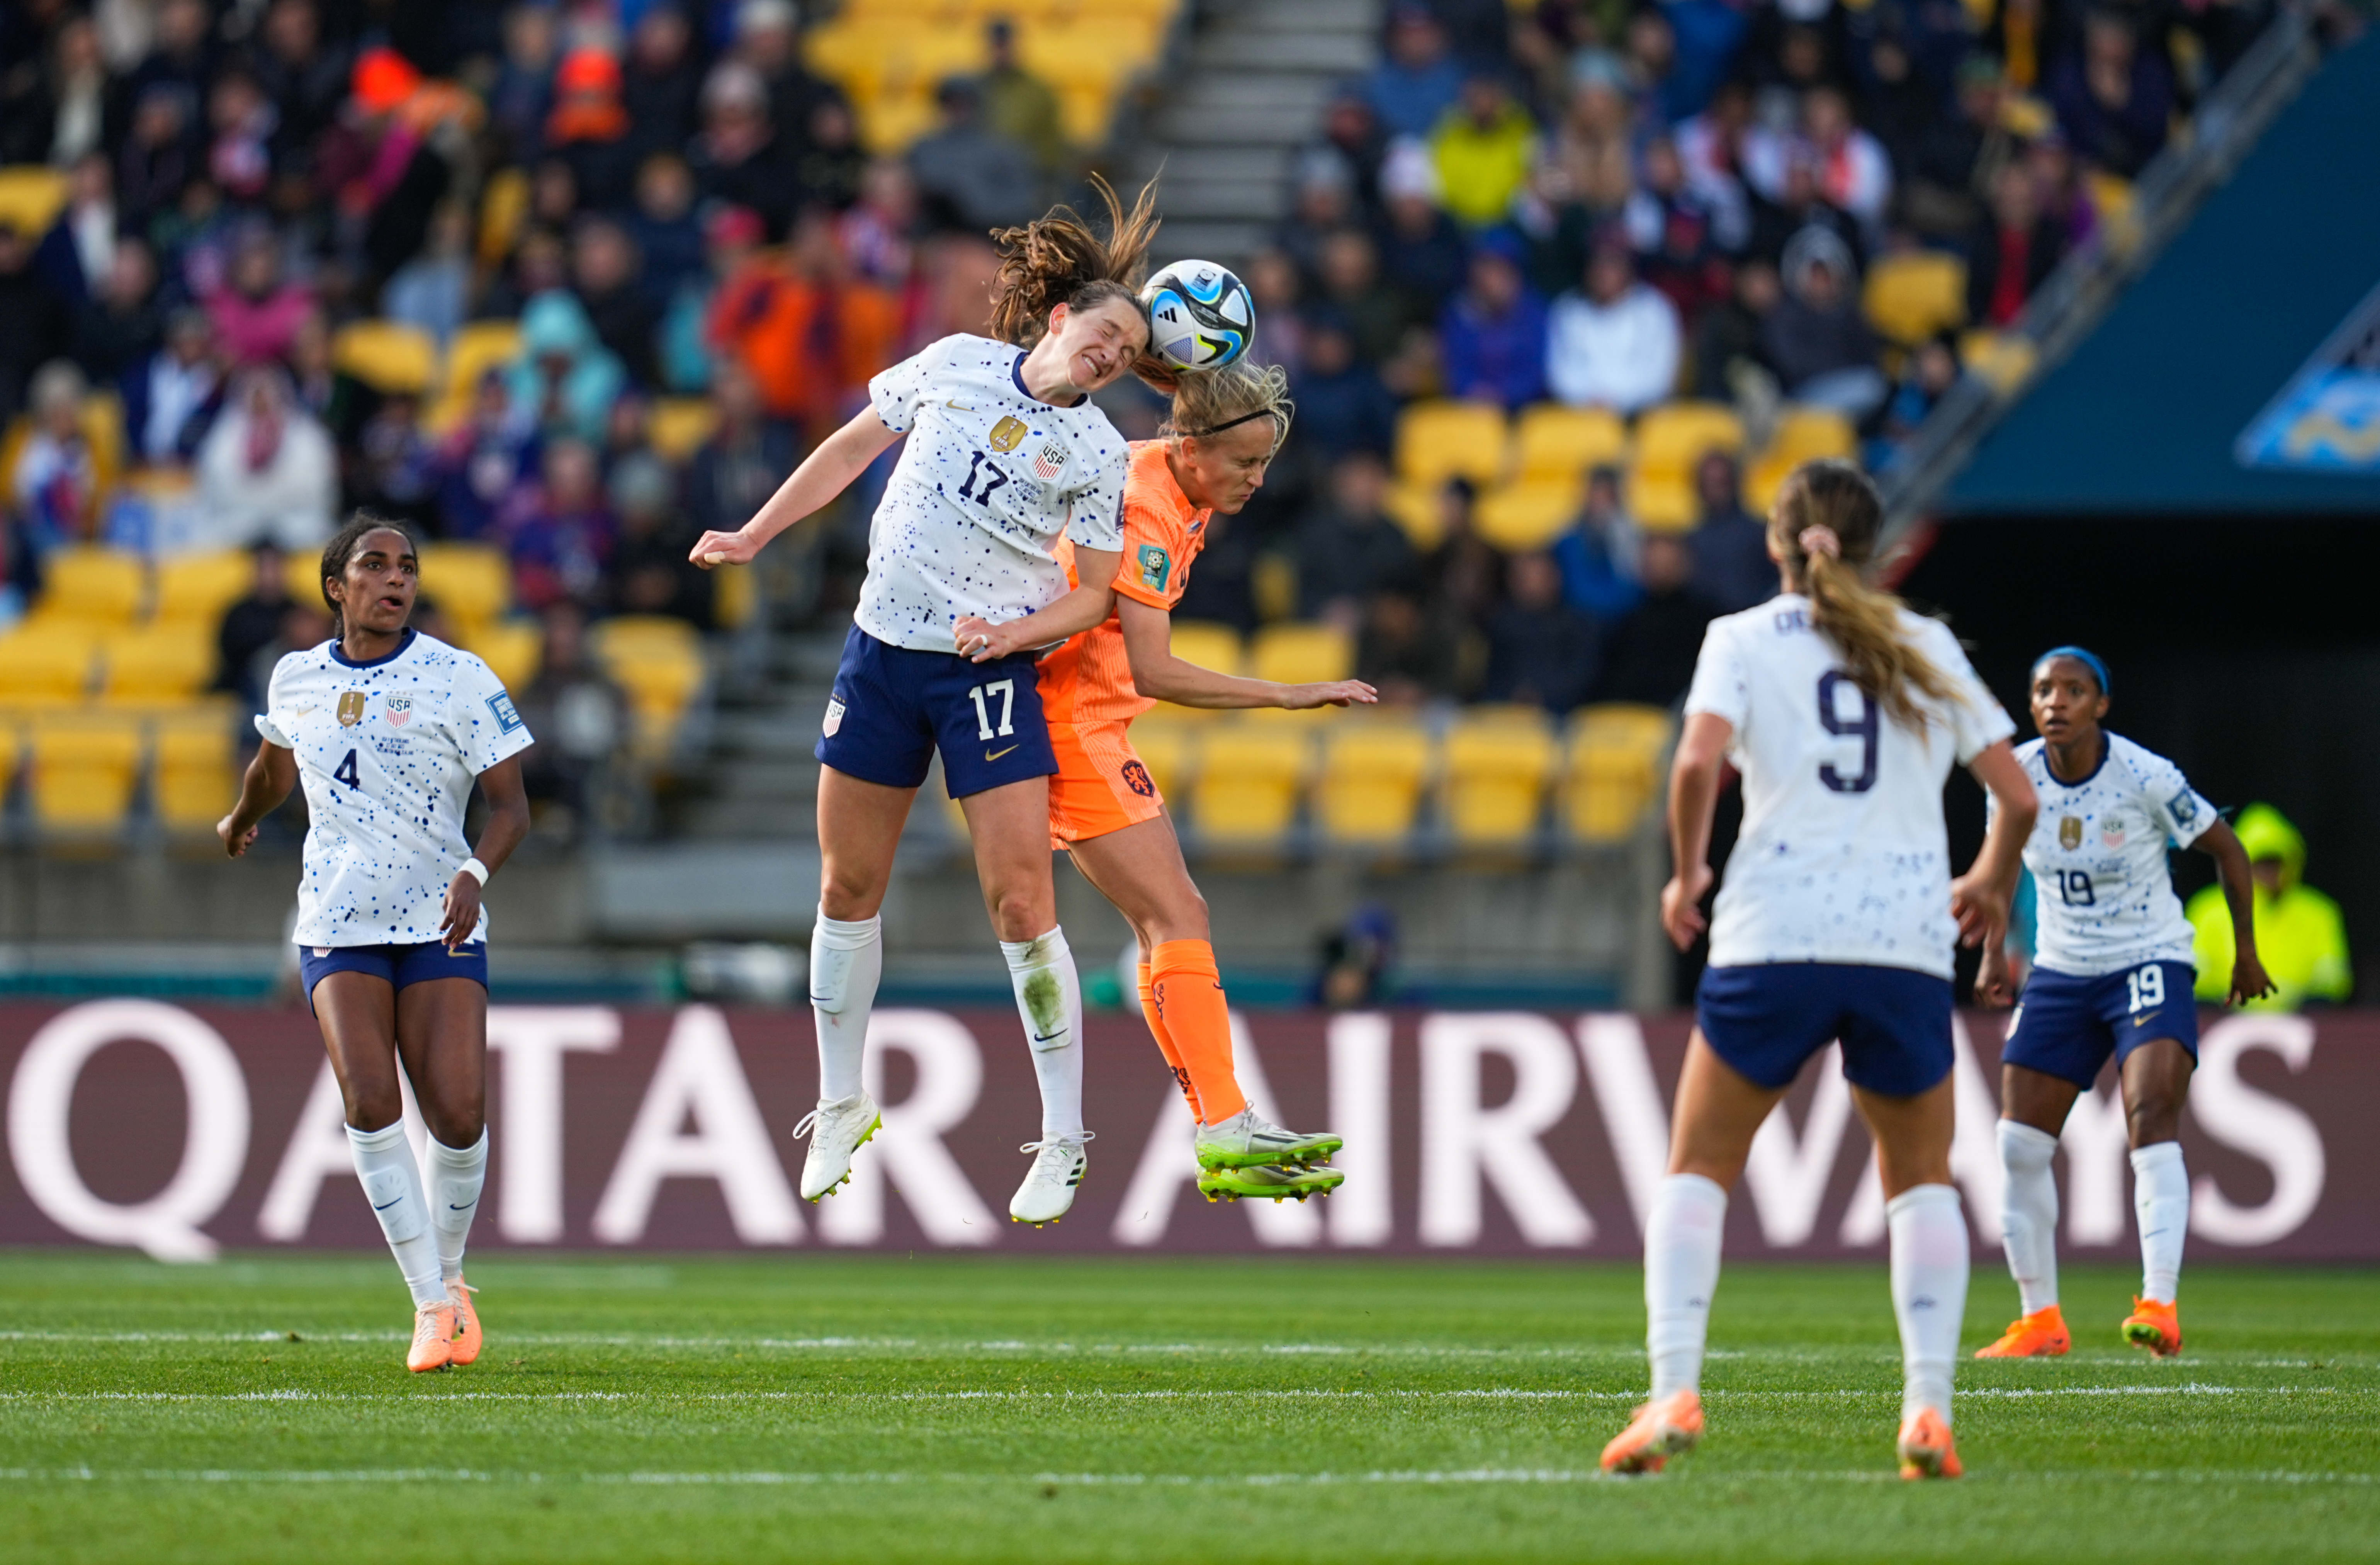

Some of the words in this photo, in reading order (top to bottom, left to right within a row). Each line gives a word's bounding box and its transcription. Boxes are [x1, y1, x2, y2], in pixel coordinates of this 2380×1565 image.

[995, 436, 1008, 447] FIFA
[1043, 445, 1065, 465] USA
[958, 451, 1009, 508] 17
[388, 698, 411, 711] USA
[829, 702, 843, 717] USA
[969, 678, 1014, 741] 17
[1819, 670, 1877, 793] 9
[333, 749, 360, 790] 4
[2055, 868, 2096, 906] 19
[2127, 964, 2165, 1014] 19
